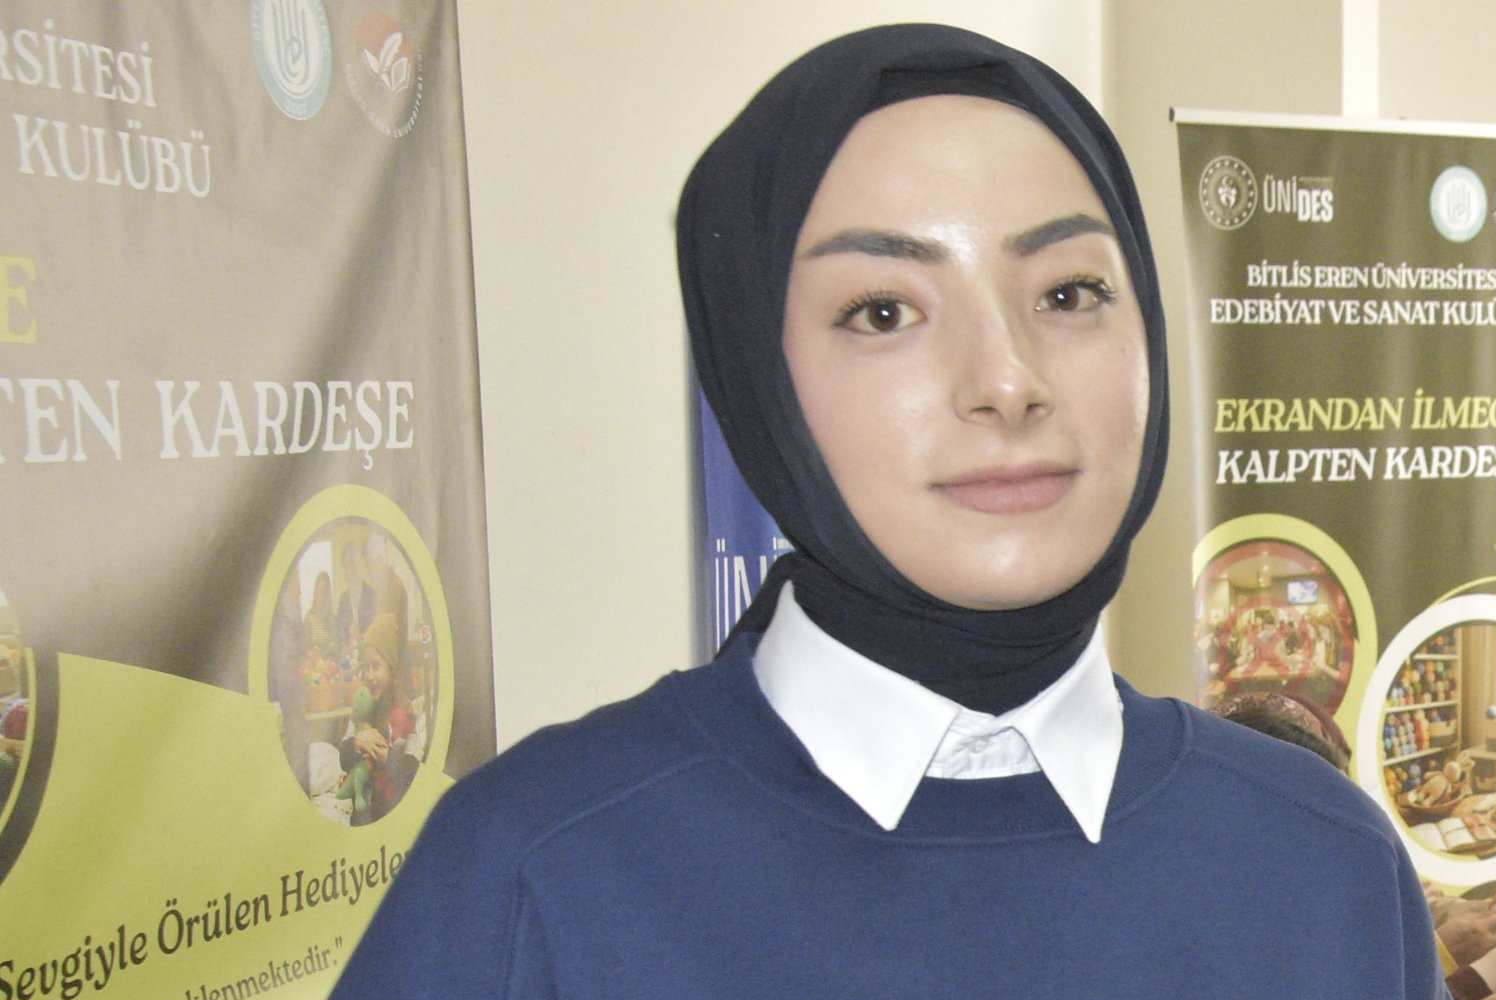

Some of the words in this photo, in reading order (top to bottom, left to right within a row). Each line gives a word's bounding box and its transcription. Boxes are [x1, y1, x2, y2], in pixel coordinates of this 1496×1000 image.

[12, 113, 211, 198] KULÜBÜ
[1247, 260, 1312, 287] BİTLİS
[1314, 266, 1369, 288] EREN
[1210, 293, 1326, 325] EDEBİYAT
[1327, 300, 1361, 324] VE
[1363, 301, 1441, 326] SANAT
[154, 379, 414, 470] KARDEŞE
[1214, 398, 1405, 432] EKRANDAN
[1216, 447, 1377, 484] KALPTEN
[157, 892, 272, 955] Örülen
[280, 845, 408, 917] Hediyele
